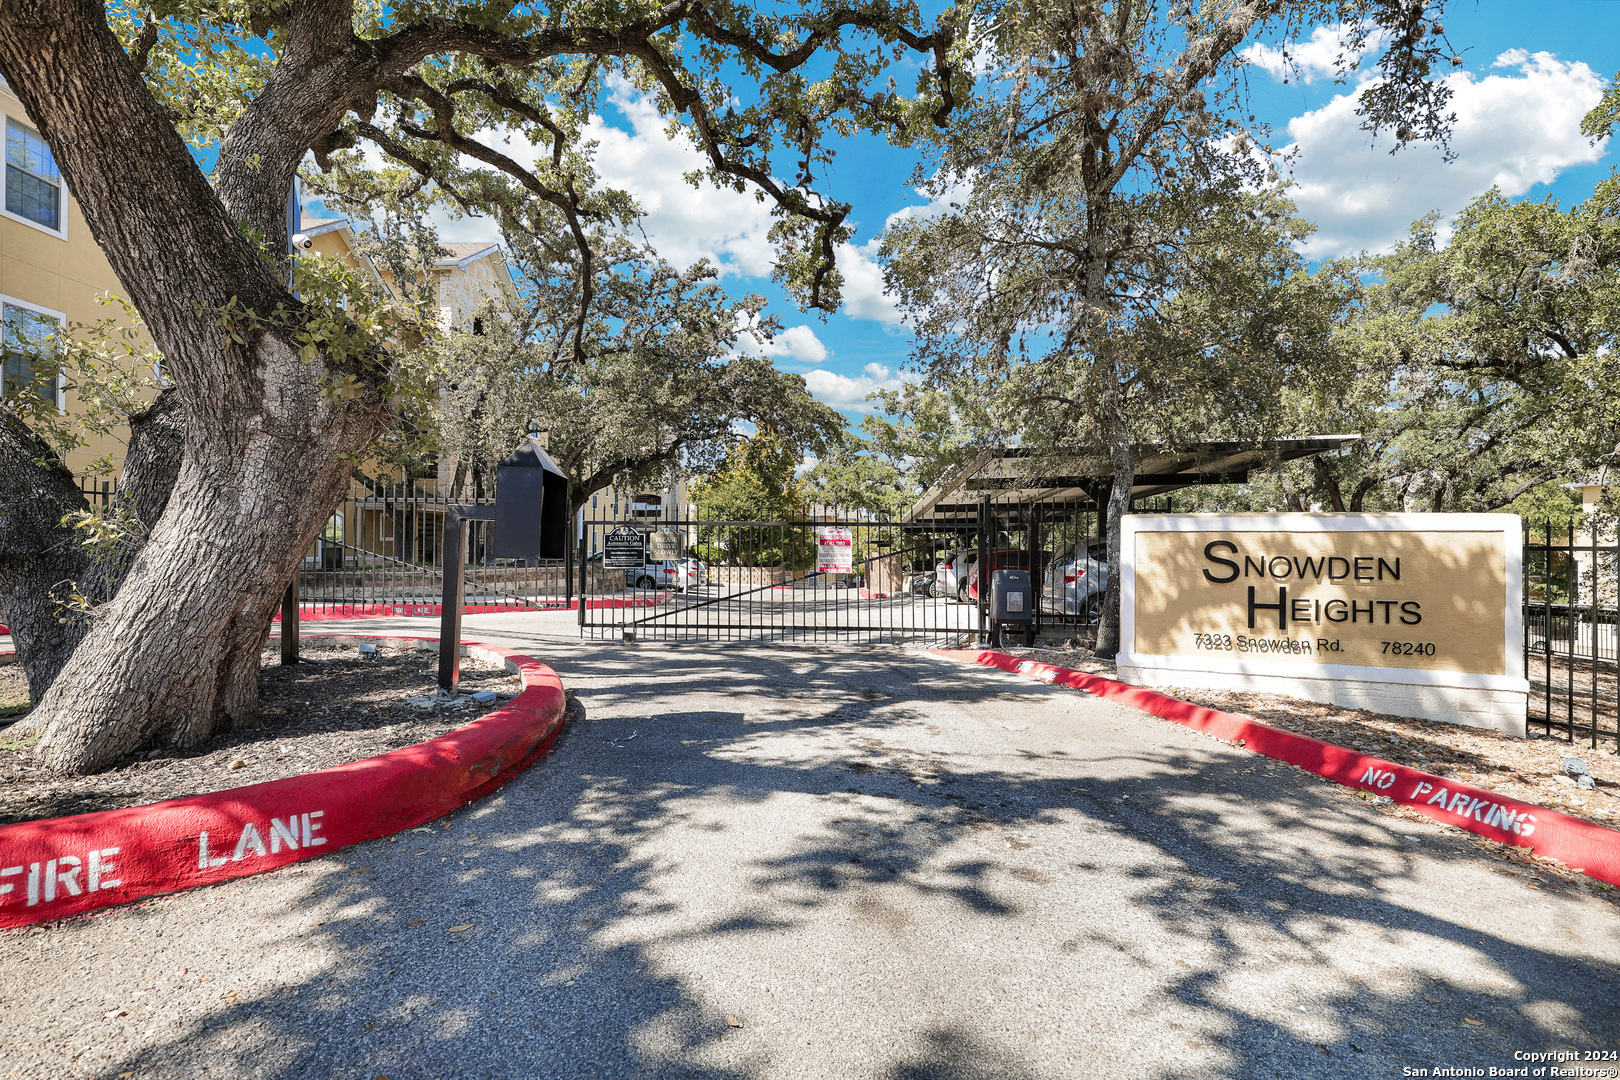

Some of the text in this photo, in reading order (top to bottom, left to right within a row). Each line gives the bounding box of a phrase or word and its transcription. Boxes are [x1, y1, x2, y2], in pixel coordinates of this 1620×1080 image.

[1202, 539, 1401, 584] SNOWDEN
[1247, 586, 1422, 630] HEIGHTS
[1194, 633, 1436, 656] 7323 Snowden Rd. 78240
[1359, 766, 1537, 837] NO PARKING
[198, 810, 328, 869] LANE
